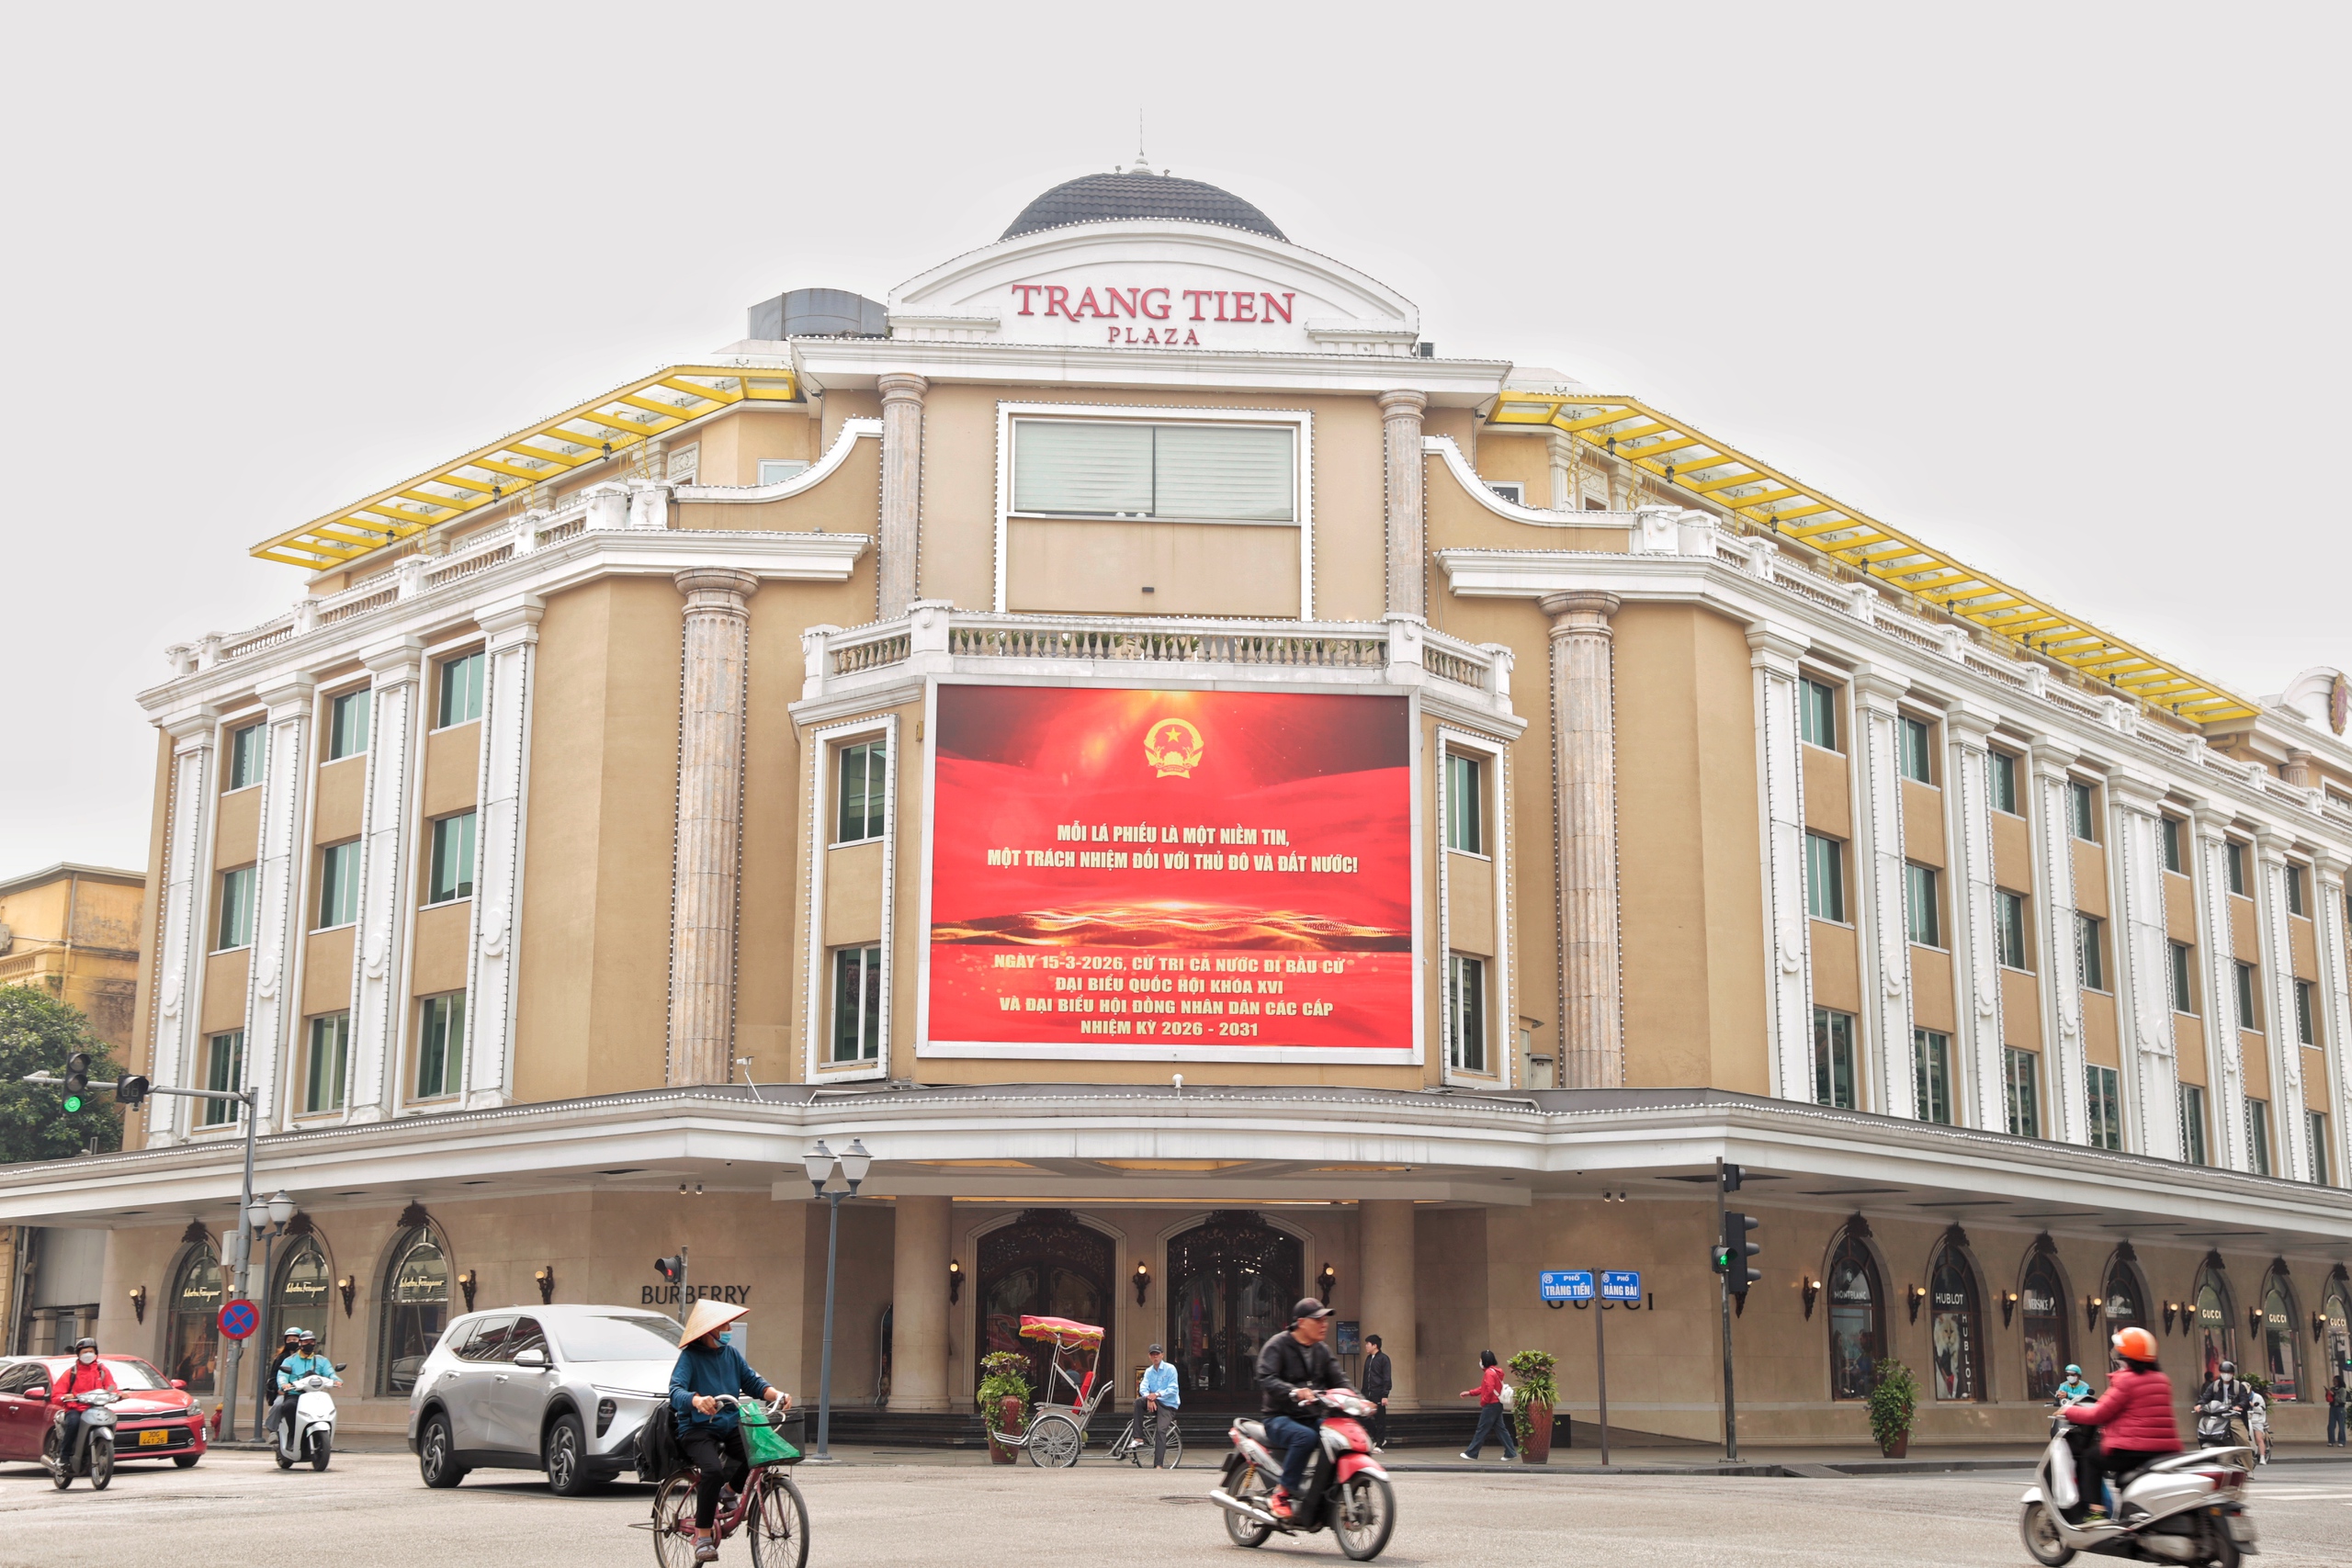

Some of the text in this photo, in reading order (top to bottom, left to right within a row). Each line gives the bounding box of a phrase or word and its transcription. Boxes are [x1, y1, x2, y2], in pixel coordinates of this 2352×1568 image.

[1012, 284, 1295, 323] TRANG TIEN
[1108, 326, 1200, 345] PLAZA
[1057, 820, 1290, 847] MỖI LÁ PHIẾU LÀ MỘT NIỀM TIN,
[988, 847, 1358, 874] MỘT TRÁCH NHIỆM ĐỐI VỚI THỦ ĐÔ VÀ ĐẤT NƯỚC!
[994, 953, 1346, 974] NGÀY 15-3-2026, CỬ TRI CẢ NƯỚC ĐI BẦU CỬ
[1056, 974, 1283, 995] ĐẠI BIỂU QUỐC HỘI KHÓA XVI
[1000, 994, 1333, 1016] VÀ ĐẠI BIỂU HỘI ĐỒNG NHÂN DÂN CÁC CẤP
[1080, 1019, 1131, 1036] NHIỆM
[1136, 1020, 1157, 1035] KỲ
[1161, 1021, 1204, 1036] 2026
[1219, 1022, 1259, 1037] 2031
[1563, 1273, 1580, 1281] PHỐ
[641, 1285, 751, 1304] BURBERRY
[1545, 1282, 1590, 1296] TRÀNG TIỀN
[1604, 1282, 1637, 1296] HÀNG BÀI
[1834, 1291, 1867, 1301] MONTBLANC
[1936, 1292, 1963, 1305] HUBLOT
[2029, 1298, 2049, 1311] VERSACE
[2201, 1309, 2222, 1319] GUCCI
[2268, 1314, 2288, 1323] GUCCI
[2329, 1317, 2347, 1326] GUCCI
[1962, 1314, 1972, 1393] HUBLOT
